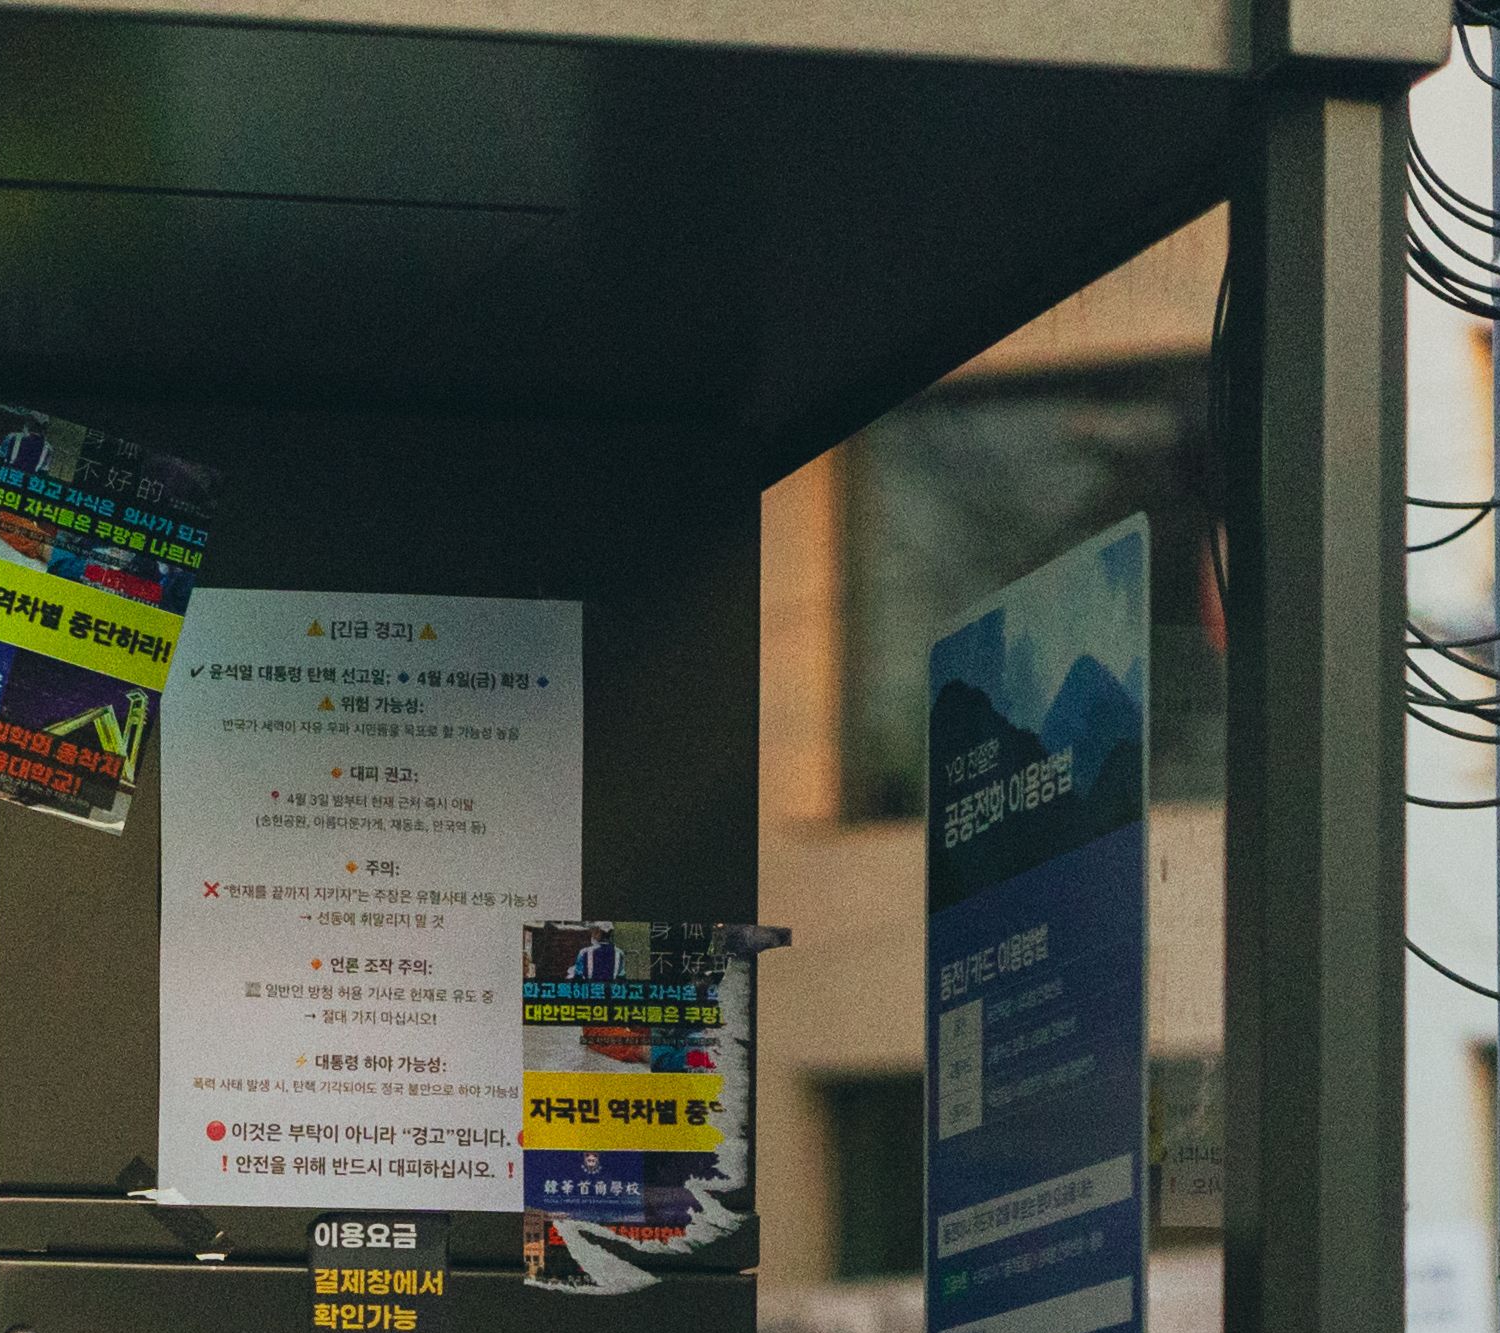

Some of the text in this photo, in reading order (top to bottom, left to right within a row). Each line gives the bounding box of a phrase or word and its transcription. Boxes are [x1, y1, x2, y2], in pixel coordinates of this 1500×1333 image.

[27, 477, 62, 500] 화교
[67, 487, 116, 517] 자식은
[123, 507, 173, 536] 의사가
[25, 497, 92, 533] 자식들은
[96, 521, 146, 550] 쿠팡을
[68, 610, 172, 663] 중단하라!
[210, 665, 253, 681] 윤석열
[259, 666, 301, 683] 대통령
[308, 668, 336, 684] 탄핵
[417, 671, 441, 687] 4월
[500, 673, 529, 689] 확정
[342, 696, 369, 713] 위험
[351, 765, 378, 783] 대피
[366, 860, 400, 876] 주의:
[331, 958, 432, 976] 언론 조작 주의:
[611, 983, 643, 999] 화교
[650, 984, 696, 1000] 자식은
[322, 1010, 346, 1024] 절대
[525, 1005, 608, 1022] 대한민국의
[614, 1005, 679, 1023] 자식들은
[316, 1055, 446, 1073] 대통령 하야 가능성:
[530, 1097, 677, 1125] 자국민 역차별
[232, 1123, 282, 1143] 이것은
[289, 1124, 338, 1145] 부탁이
[345, 1125, 395, 1145] 아니라
[236, 1155, 286, 1176] 안전을
[293, 1157, 325, 1176] 위해
[333, 1158, 382, 1177] 반드시
[315, 1223, 417, 1249] 이용요금
[315, 1269, 444, 1297] 결제창에서
[313, 1303, 418, 1331] 확인가능
